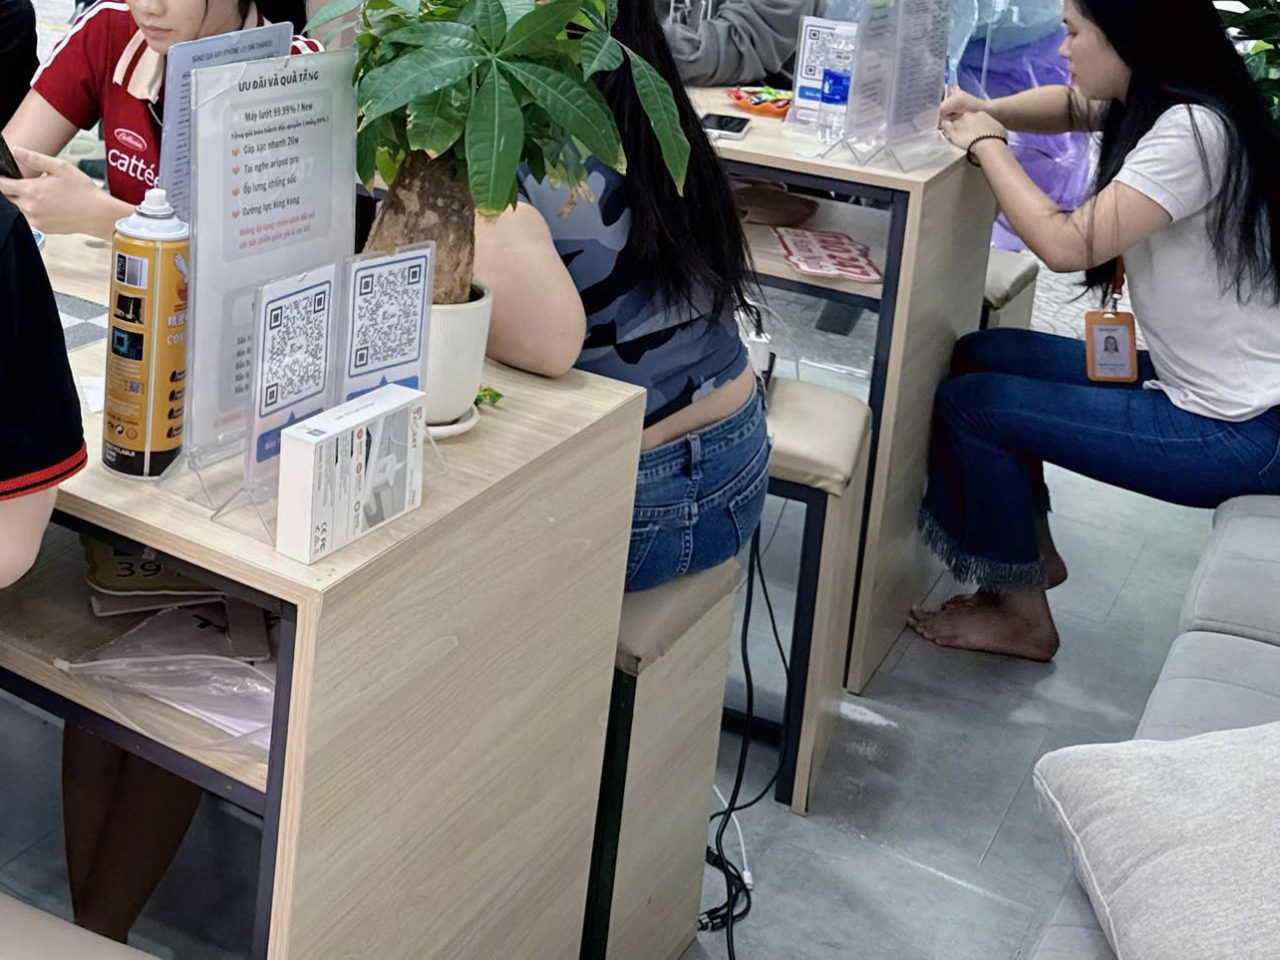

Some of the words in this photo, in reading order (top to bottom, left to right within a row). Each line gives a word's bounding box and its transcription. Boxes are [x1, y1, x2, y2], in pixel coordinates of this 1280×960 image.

[268, 73, 279, 87] VÀ
[280, 70, 298, 87] QUÀ
[299, 68, 319, 85] TẶNG
[115, 561, 162, 578] 39
